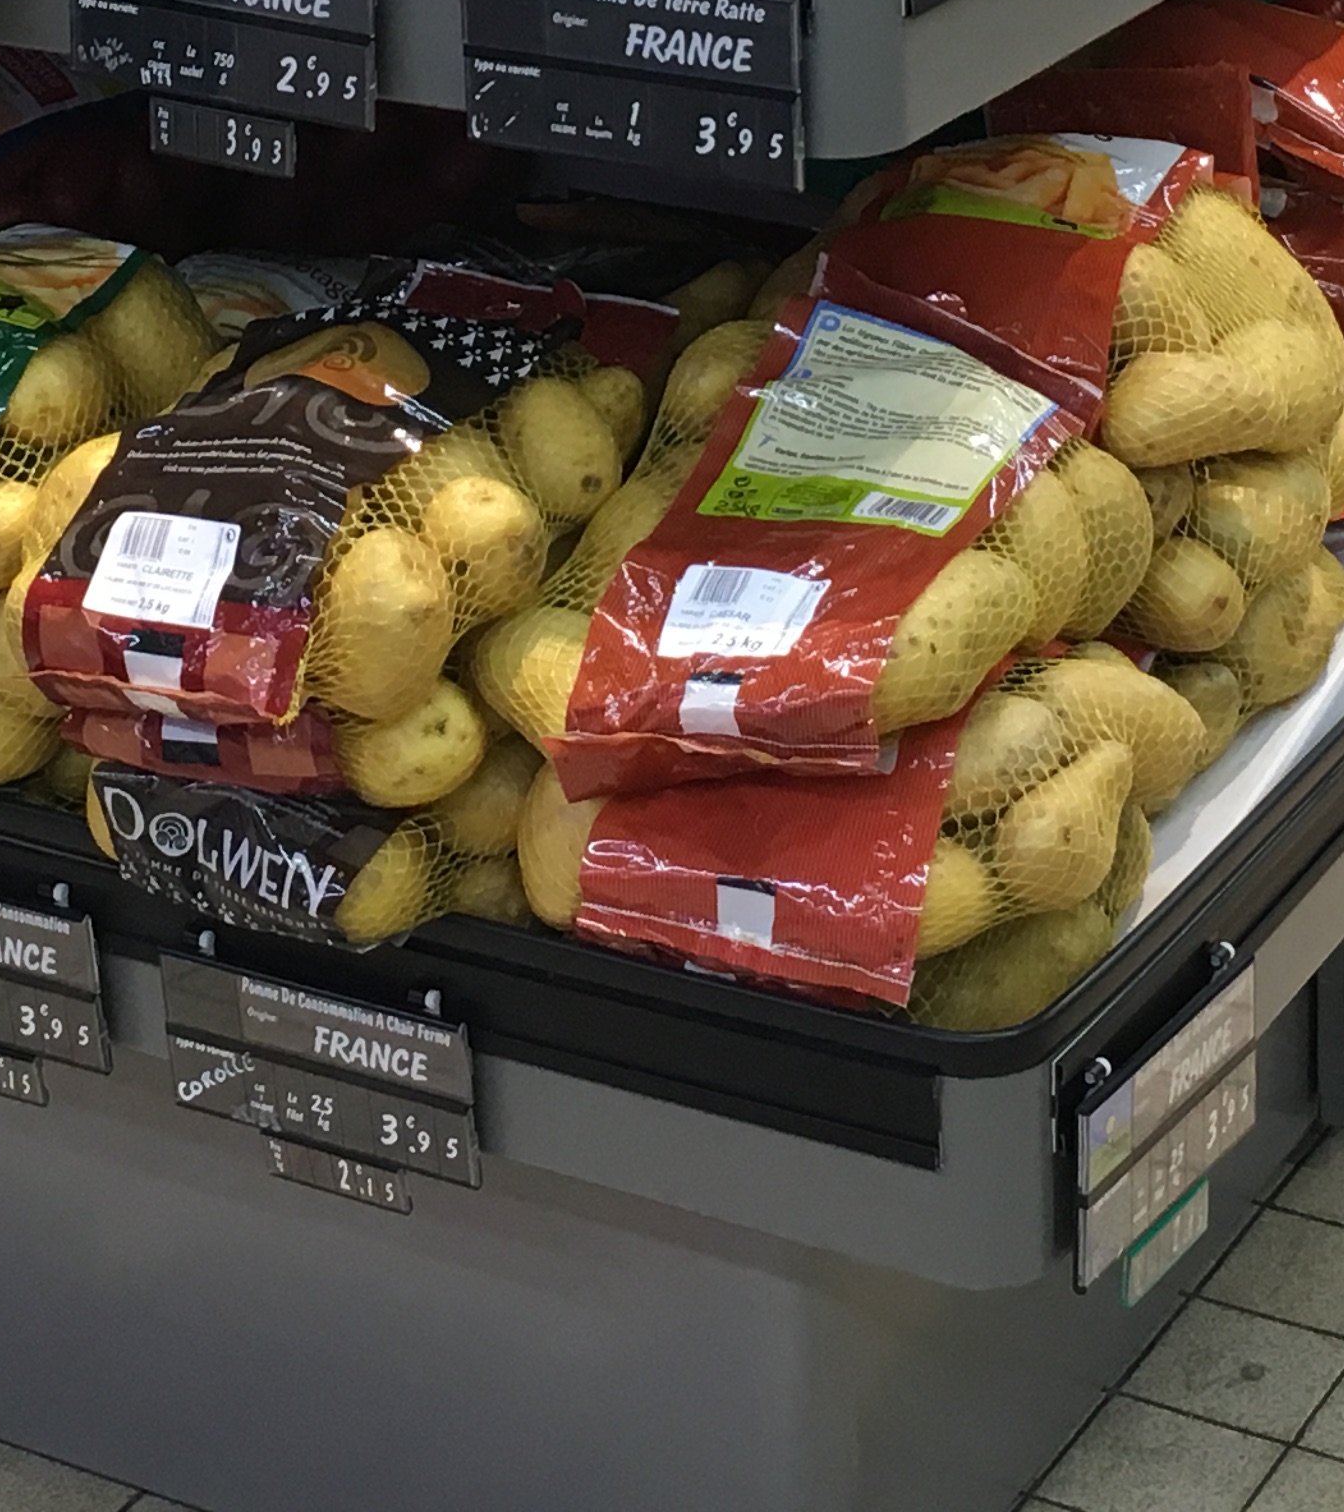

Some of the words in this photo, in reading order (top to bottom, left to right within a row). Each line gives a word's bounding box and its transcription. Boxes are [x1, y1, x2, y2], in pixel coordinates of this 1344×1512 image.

[213, 52, 235, 68] 750
[625, 22, 754, 73] FRANCE
[630, 101, 640, 126] 1
[142, 565, 194, 582] CLAIRETTE
[155, 598, 171, 615] kg
[709, 610, 751, 622] CAESAR
[740, 636, 763, 651] kg
[241, 976, 280, 1004] Pomme
[282, 986, 296, 1006] De
[298, 992, 373, 1027] Consommation
[376, 1012, 384, 1027] A
[386, 1014, 414, 1037] Chair
[417, 1025, 451, 1047] Ferme
[313, 1025, 428, 1081] FRANCE
[1169, 1018, 1232, 1105] FRANCE
[177, 1051, 256, 1102] COROLLE
